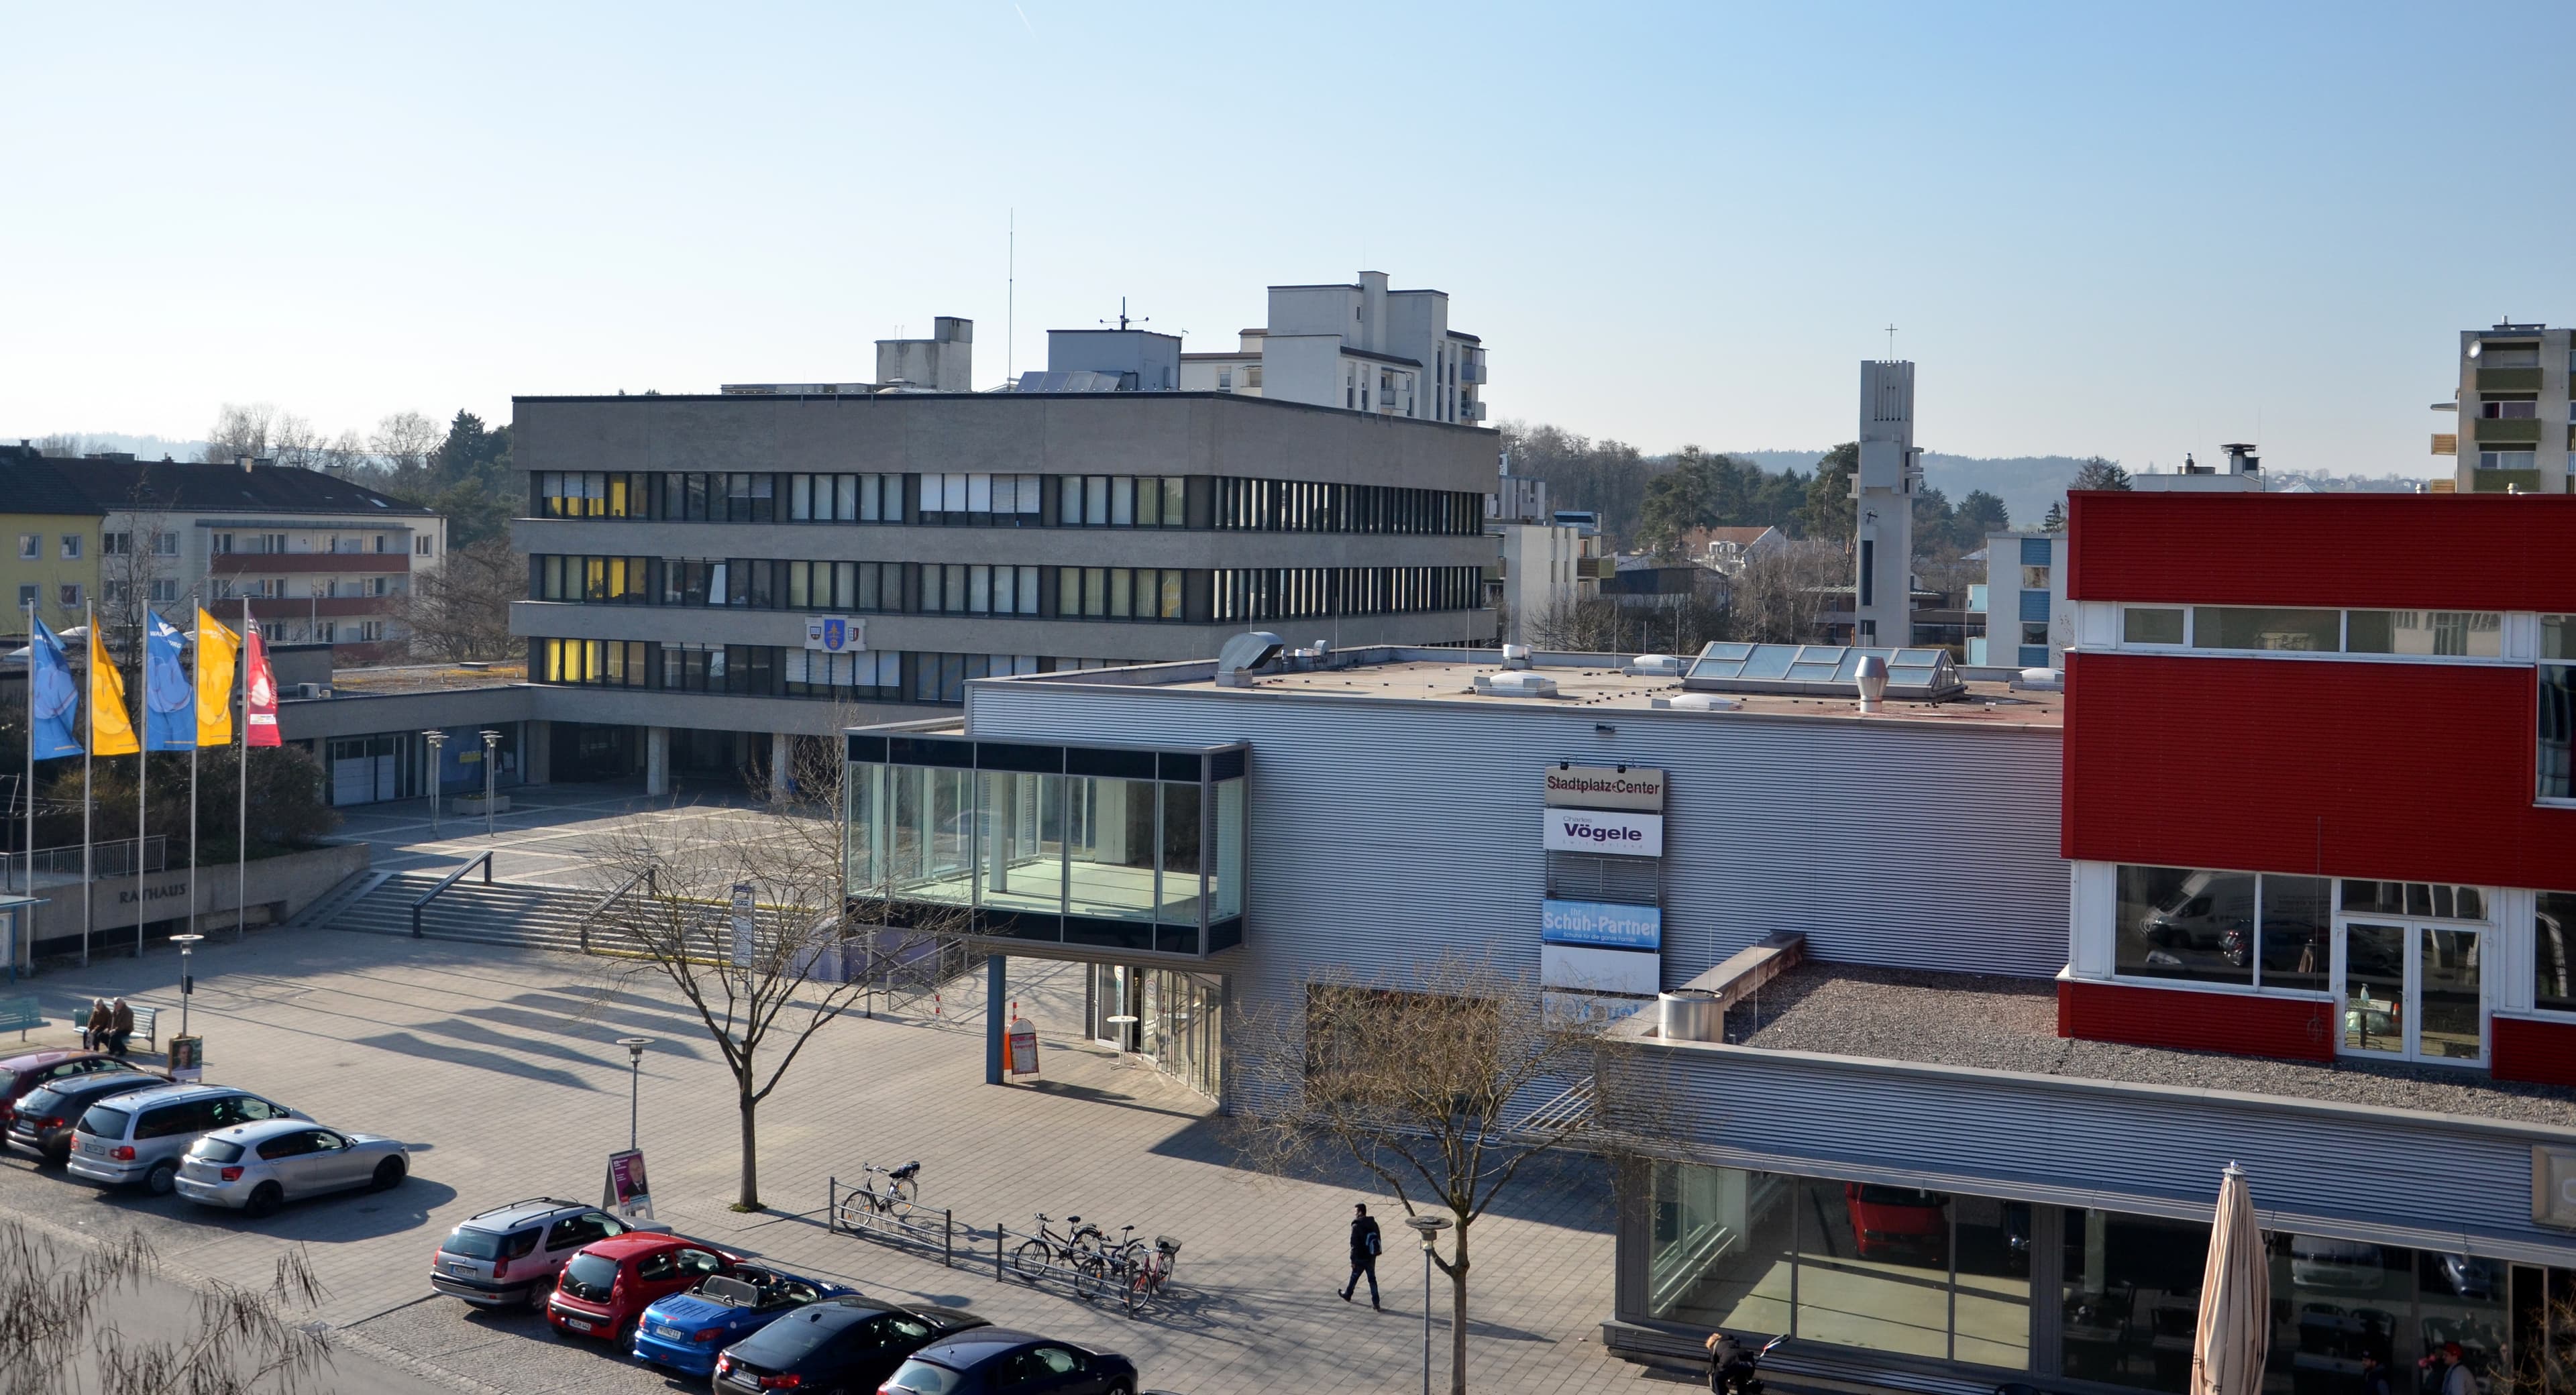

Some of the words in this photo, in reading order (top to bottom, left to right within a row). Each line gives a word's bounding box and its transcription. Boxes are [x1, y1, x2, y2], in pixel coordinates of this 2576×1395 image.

[1564, 823, 1642, 842] Vögele
[119, 883, 186, 903] RATHAUS
[1570, 908, 1582, 916] Ihr
[1544, 911, 1658, 936] Schuh-Partner
